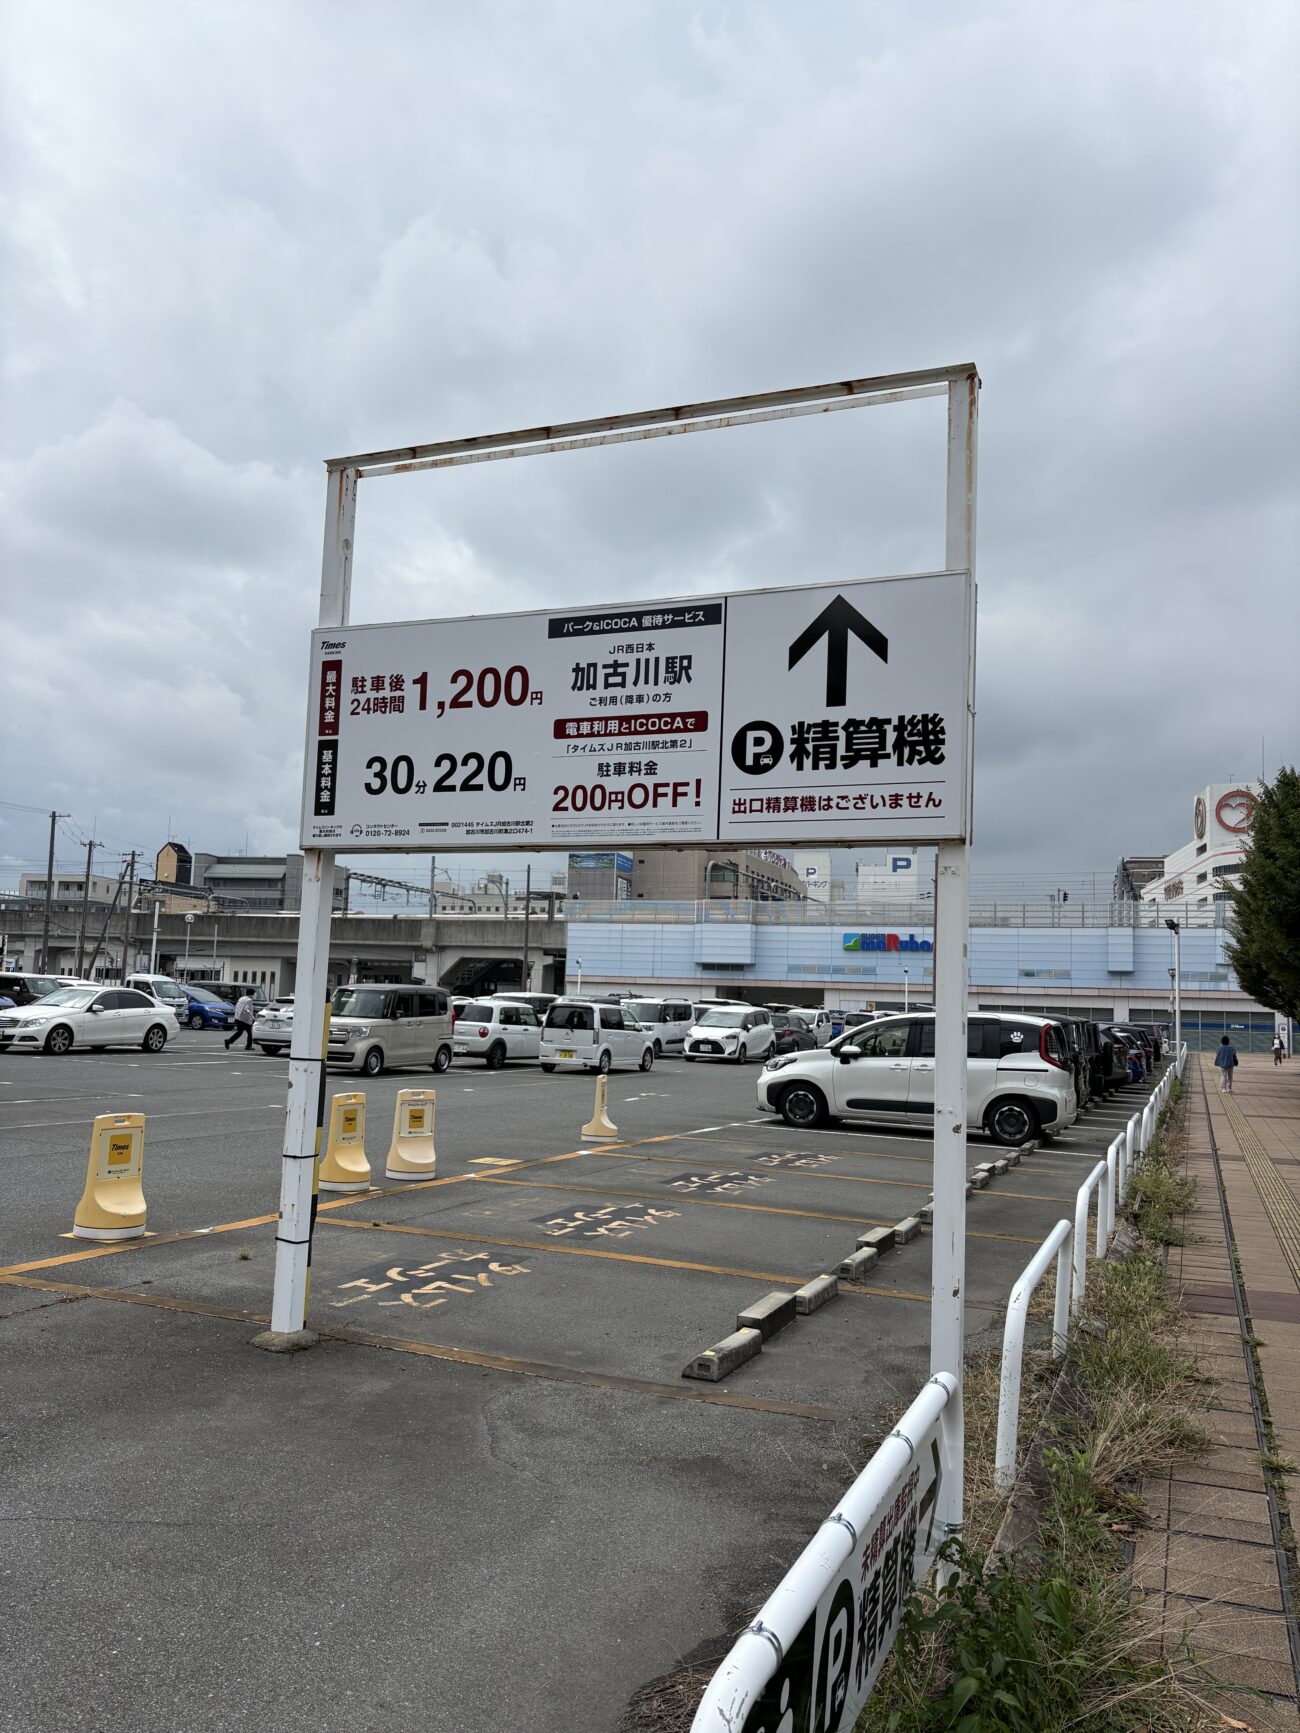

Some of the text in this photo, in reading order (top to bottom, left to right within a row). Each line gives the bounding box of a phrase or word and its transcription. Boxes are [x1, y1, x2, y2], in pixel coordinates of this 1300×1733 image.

[563, 611, 705, 633] パーク&ICOCA 優待サービス
[320, 640, 347, 650] Times
[608, 642, 656, 655] JR西日本
[570, 654, 693, 691] 加古川駅
[350, 673, 405, 695] 駐車後
[412, 665, 543, 719] 1,200円
[324, 670, 338, 723] 最大料金
[349, 695, 405, 716] 24時間
[589, 692, 673, 707] ご利用(降車)の方
[565, 716, 696, 736] 電車利用とICOCAで
[789, 713, 946, 771] 精算機
[320, 749, 333, 802] 基本料金
[597, 760, 658, 778] 駐車料金
[552, 778, 702, 812] 200円OFF!
[731, 791, 943, 815] 出口精算機はございません
[365, 829, 410, 837] 0120-72-8924
[806, 867, 817, 878] P
[891, 857, 912, 873] P
[861, 933, 887, 941] SUPER
[111, 1143, 130, 1151] Times
[855, 1500, 918, 1695] 精算機
